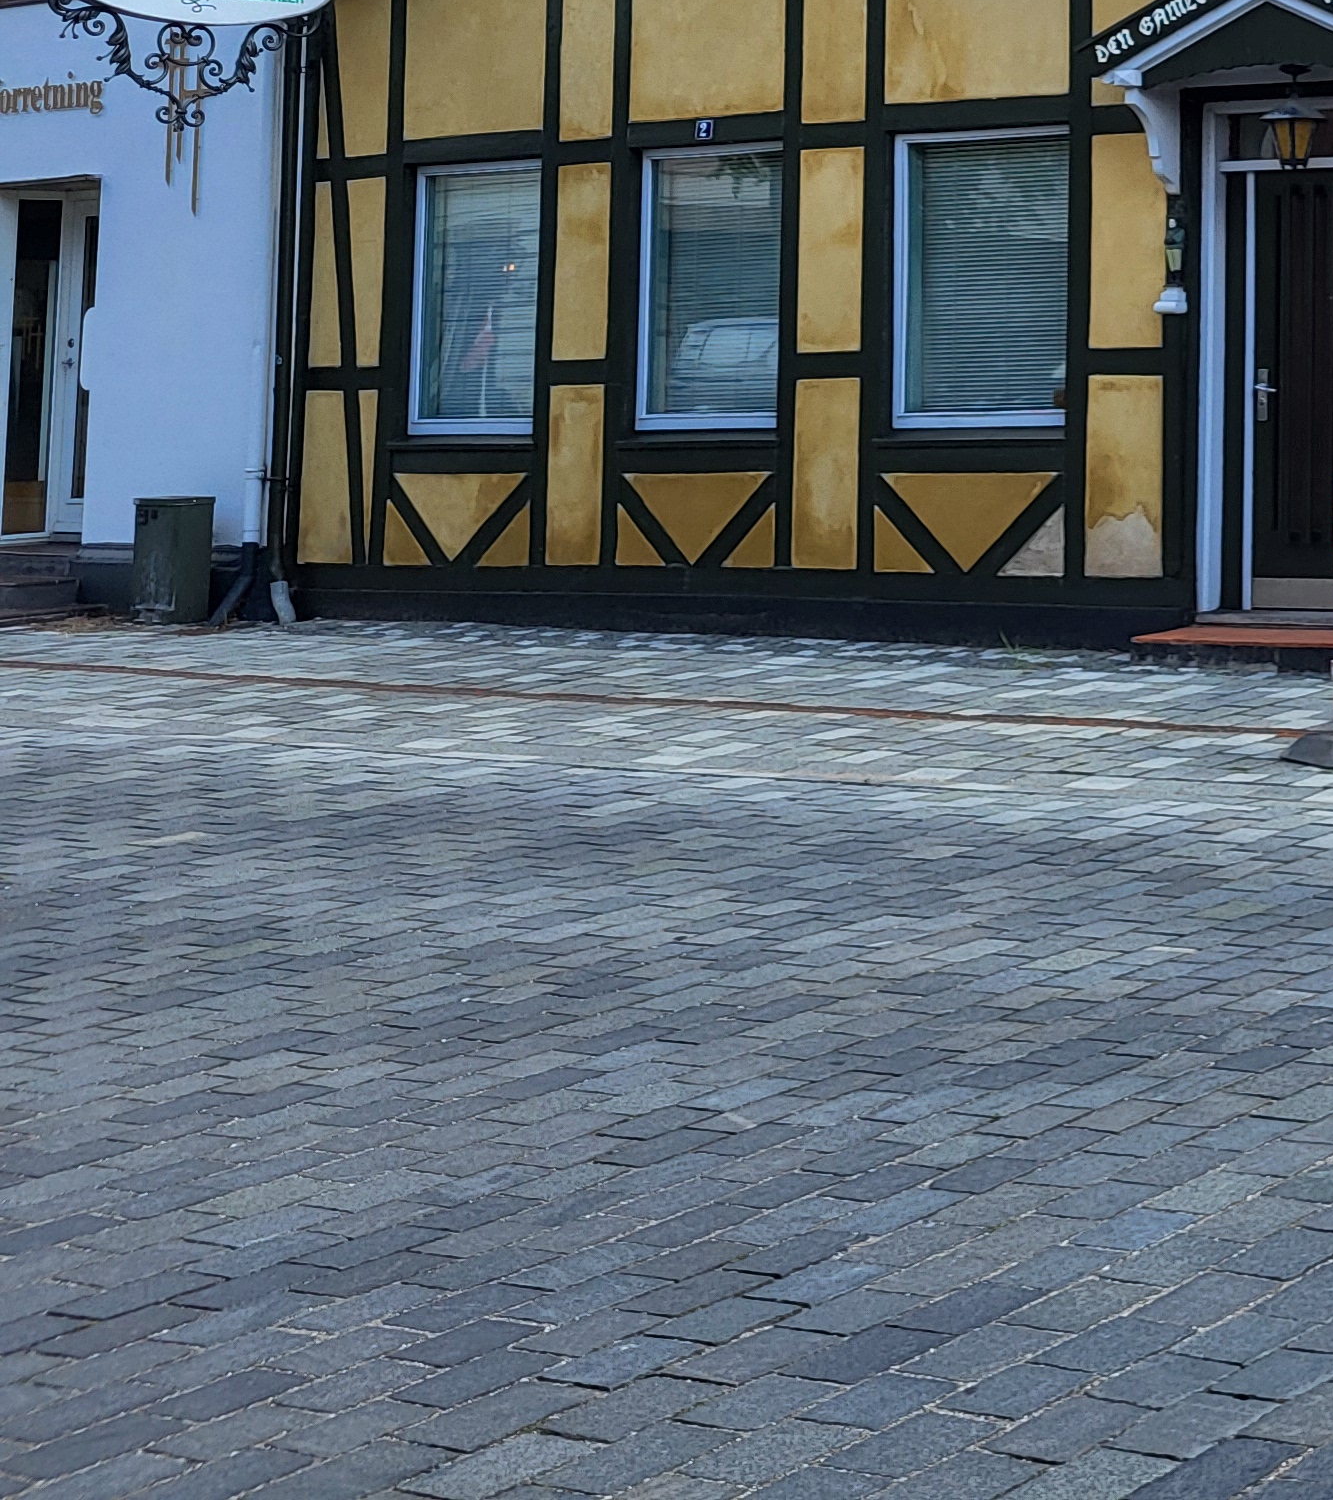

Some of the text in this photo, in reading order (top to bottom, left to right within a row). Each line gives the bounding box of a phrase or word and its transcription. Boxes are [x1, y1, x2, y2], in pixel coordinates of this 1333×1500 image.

[1095, 29, 1134, 63] DEN
[0, 71, 103, 115] orretning
[699, 122, 708, 137] 2
